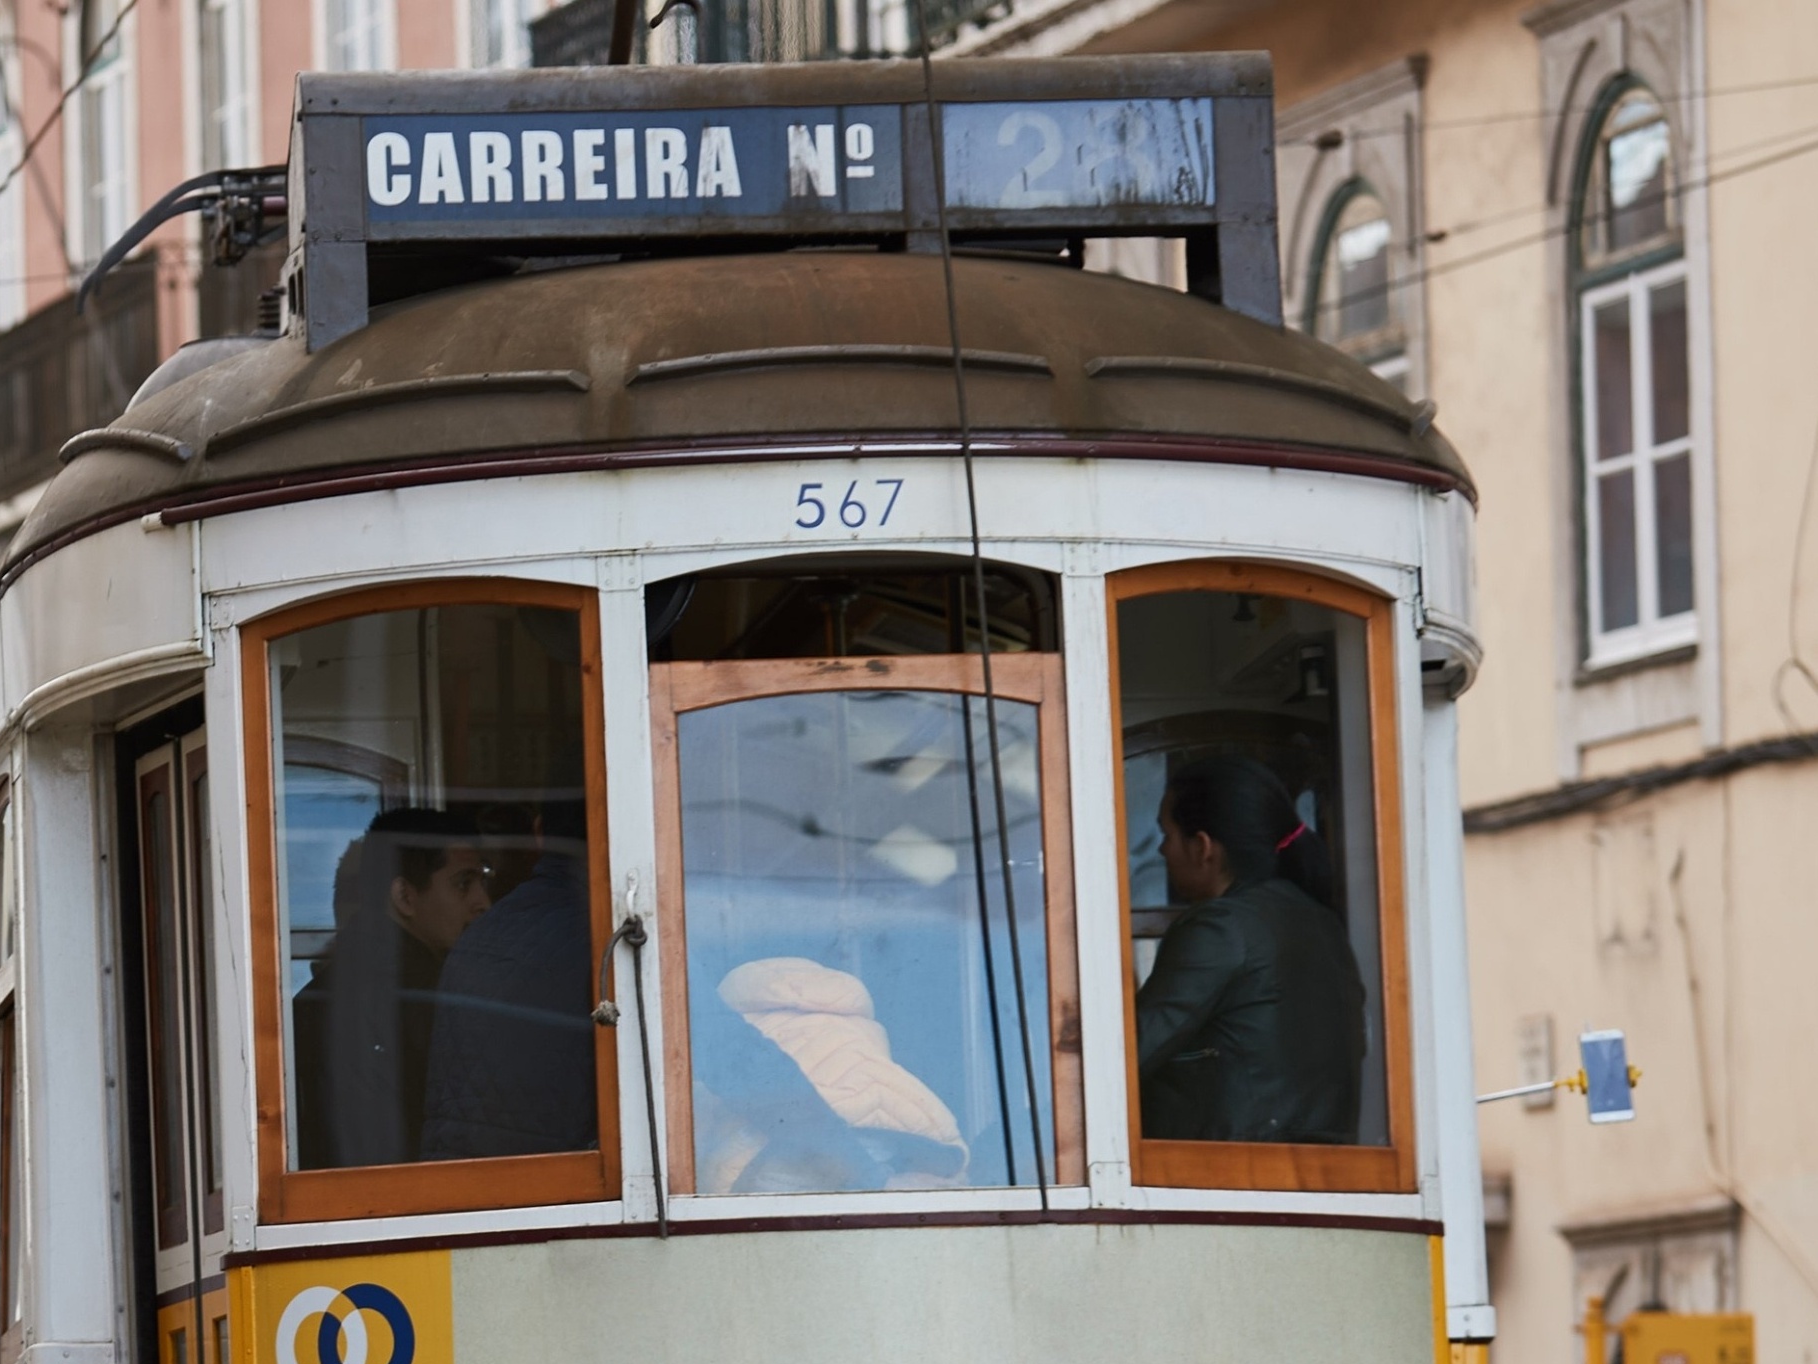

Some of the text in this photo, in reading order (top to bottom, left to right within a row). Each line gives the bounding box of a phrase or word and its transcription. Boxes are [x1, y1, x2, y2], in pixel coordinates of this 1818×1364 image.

[367, 125, 744, 206] CARREIRA
[788, 122, 875, 198] Nº
[795, 478, 905, 530] 567
